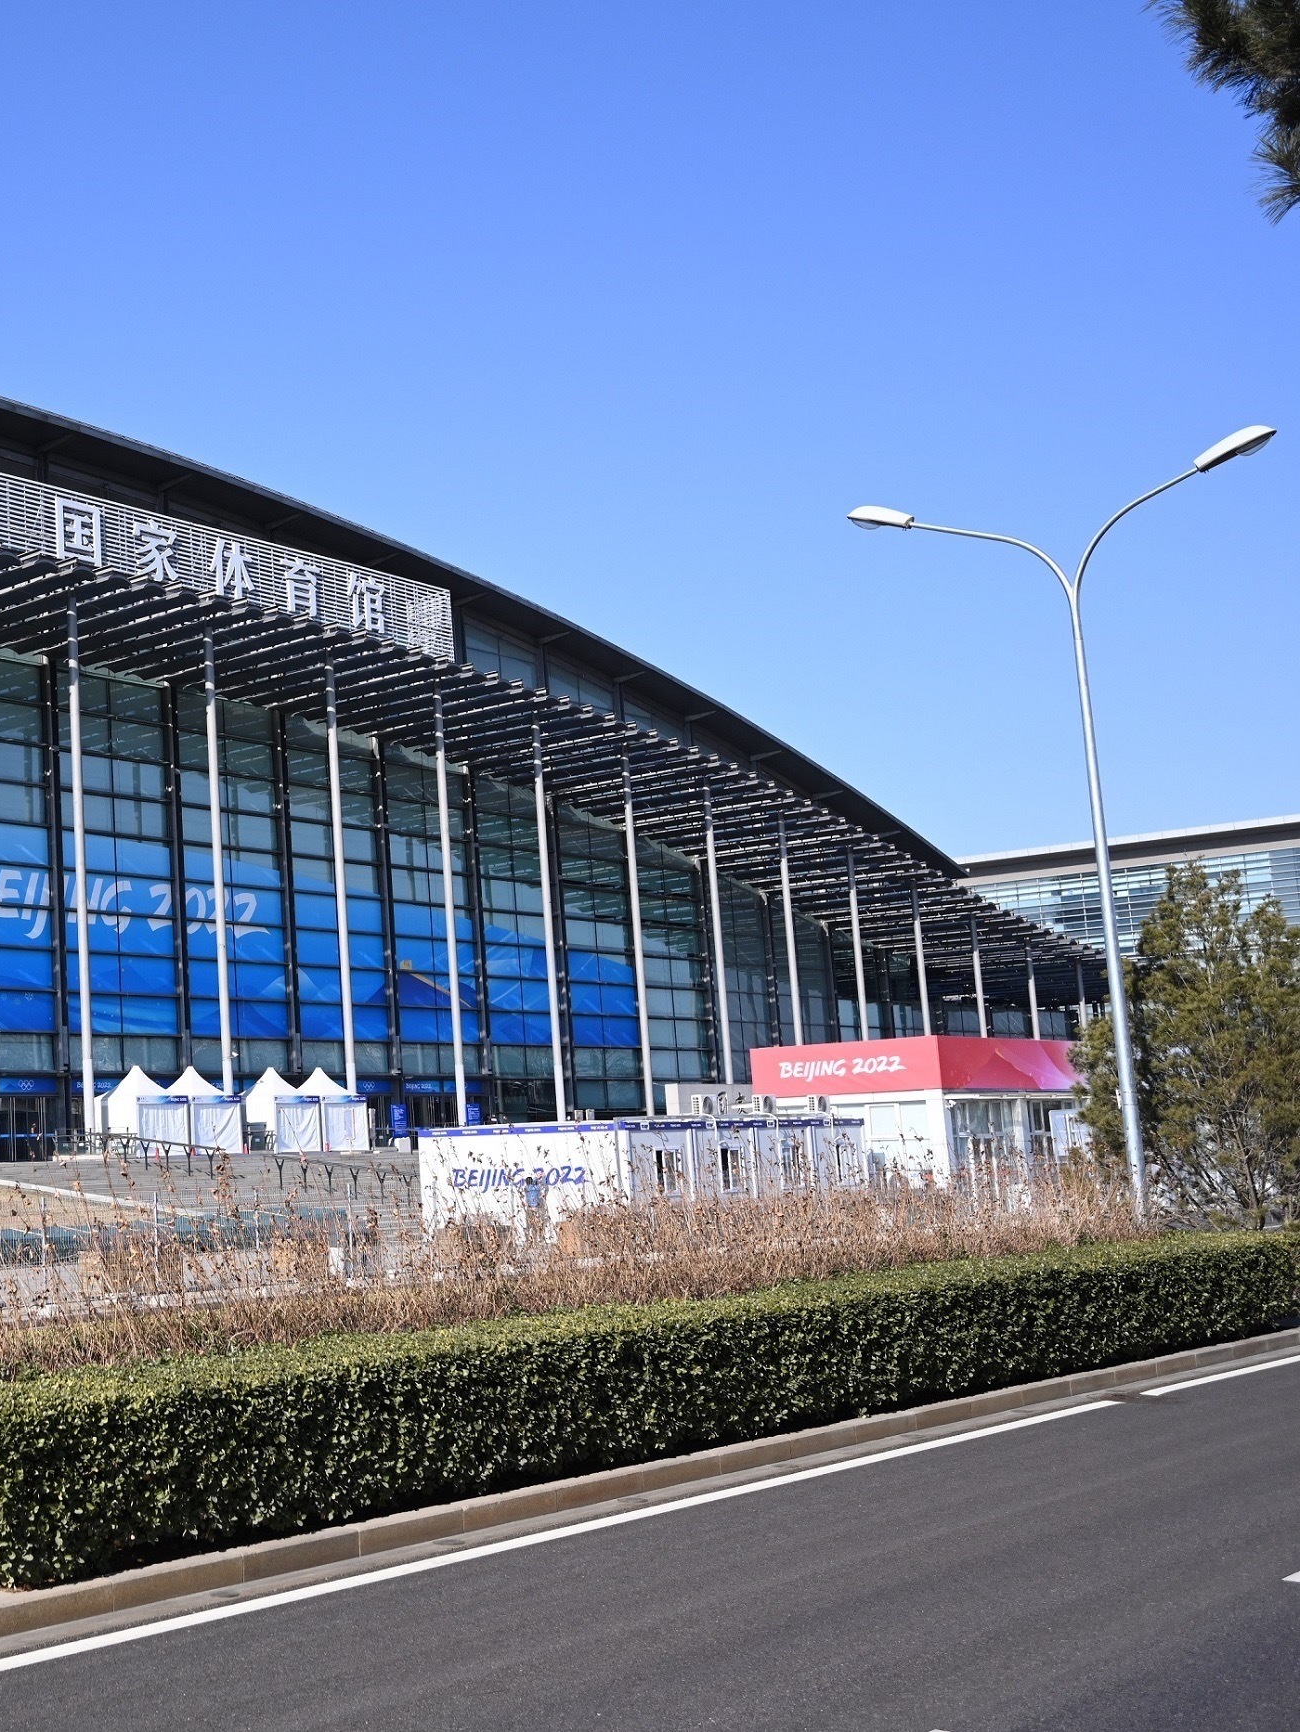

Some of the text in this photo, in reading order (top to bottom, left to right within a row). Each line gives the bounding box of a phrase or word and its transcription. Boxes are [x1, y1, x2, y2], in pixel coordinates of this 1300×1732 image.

[55, 497, 385, 634] 国家体育馆
[779, 1055, 907, 1082] BEIJING 2022
[452, 1167, 525, 1193] BEIJING
